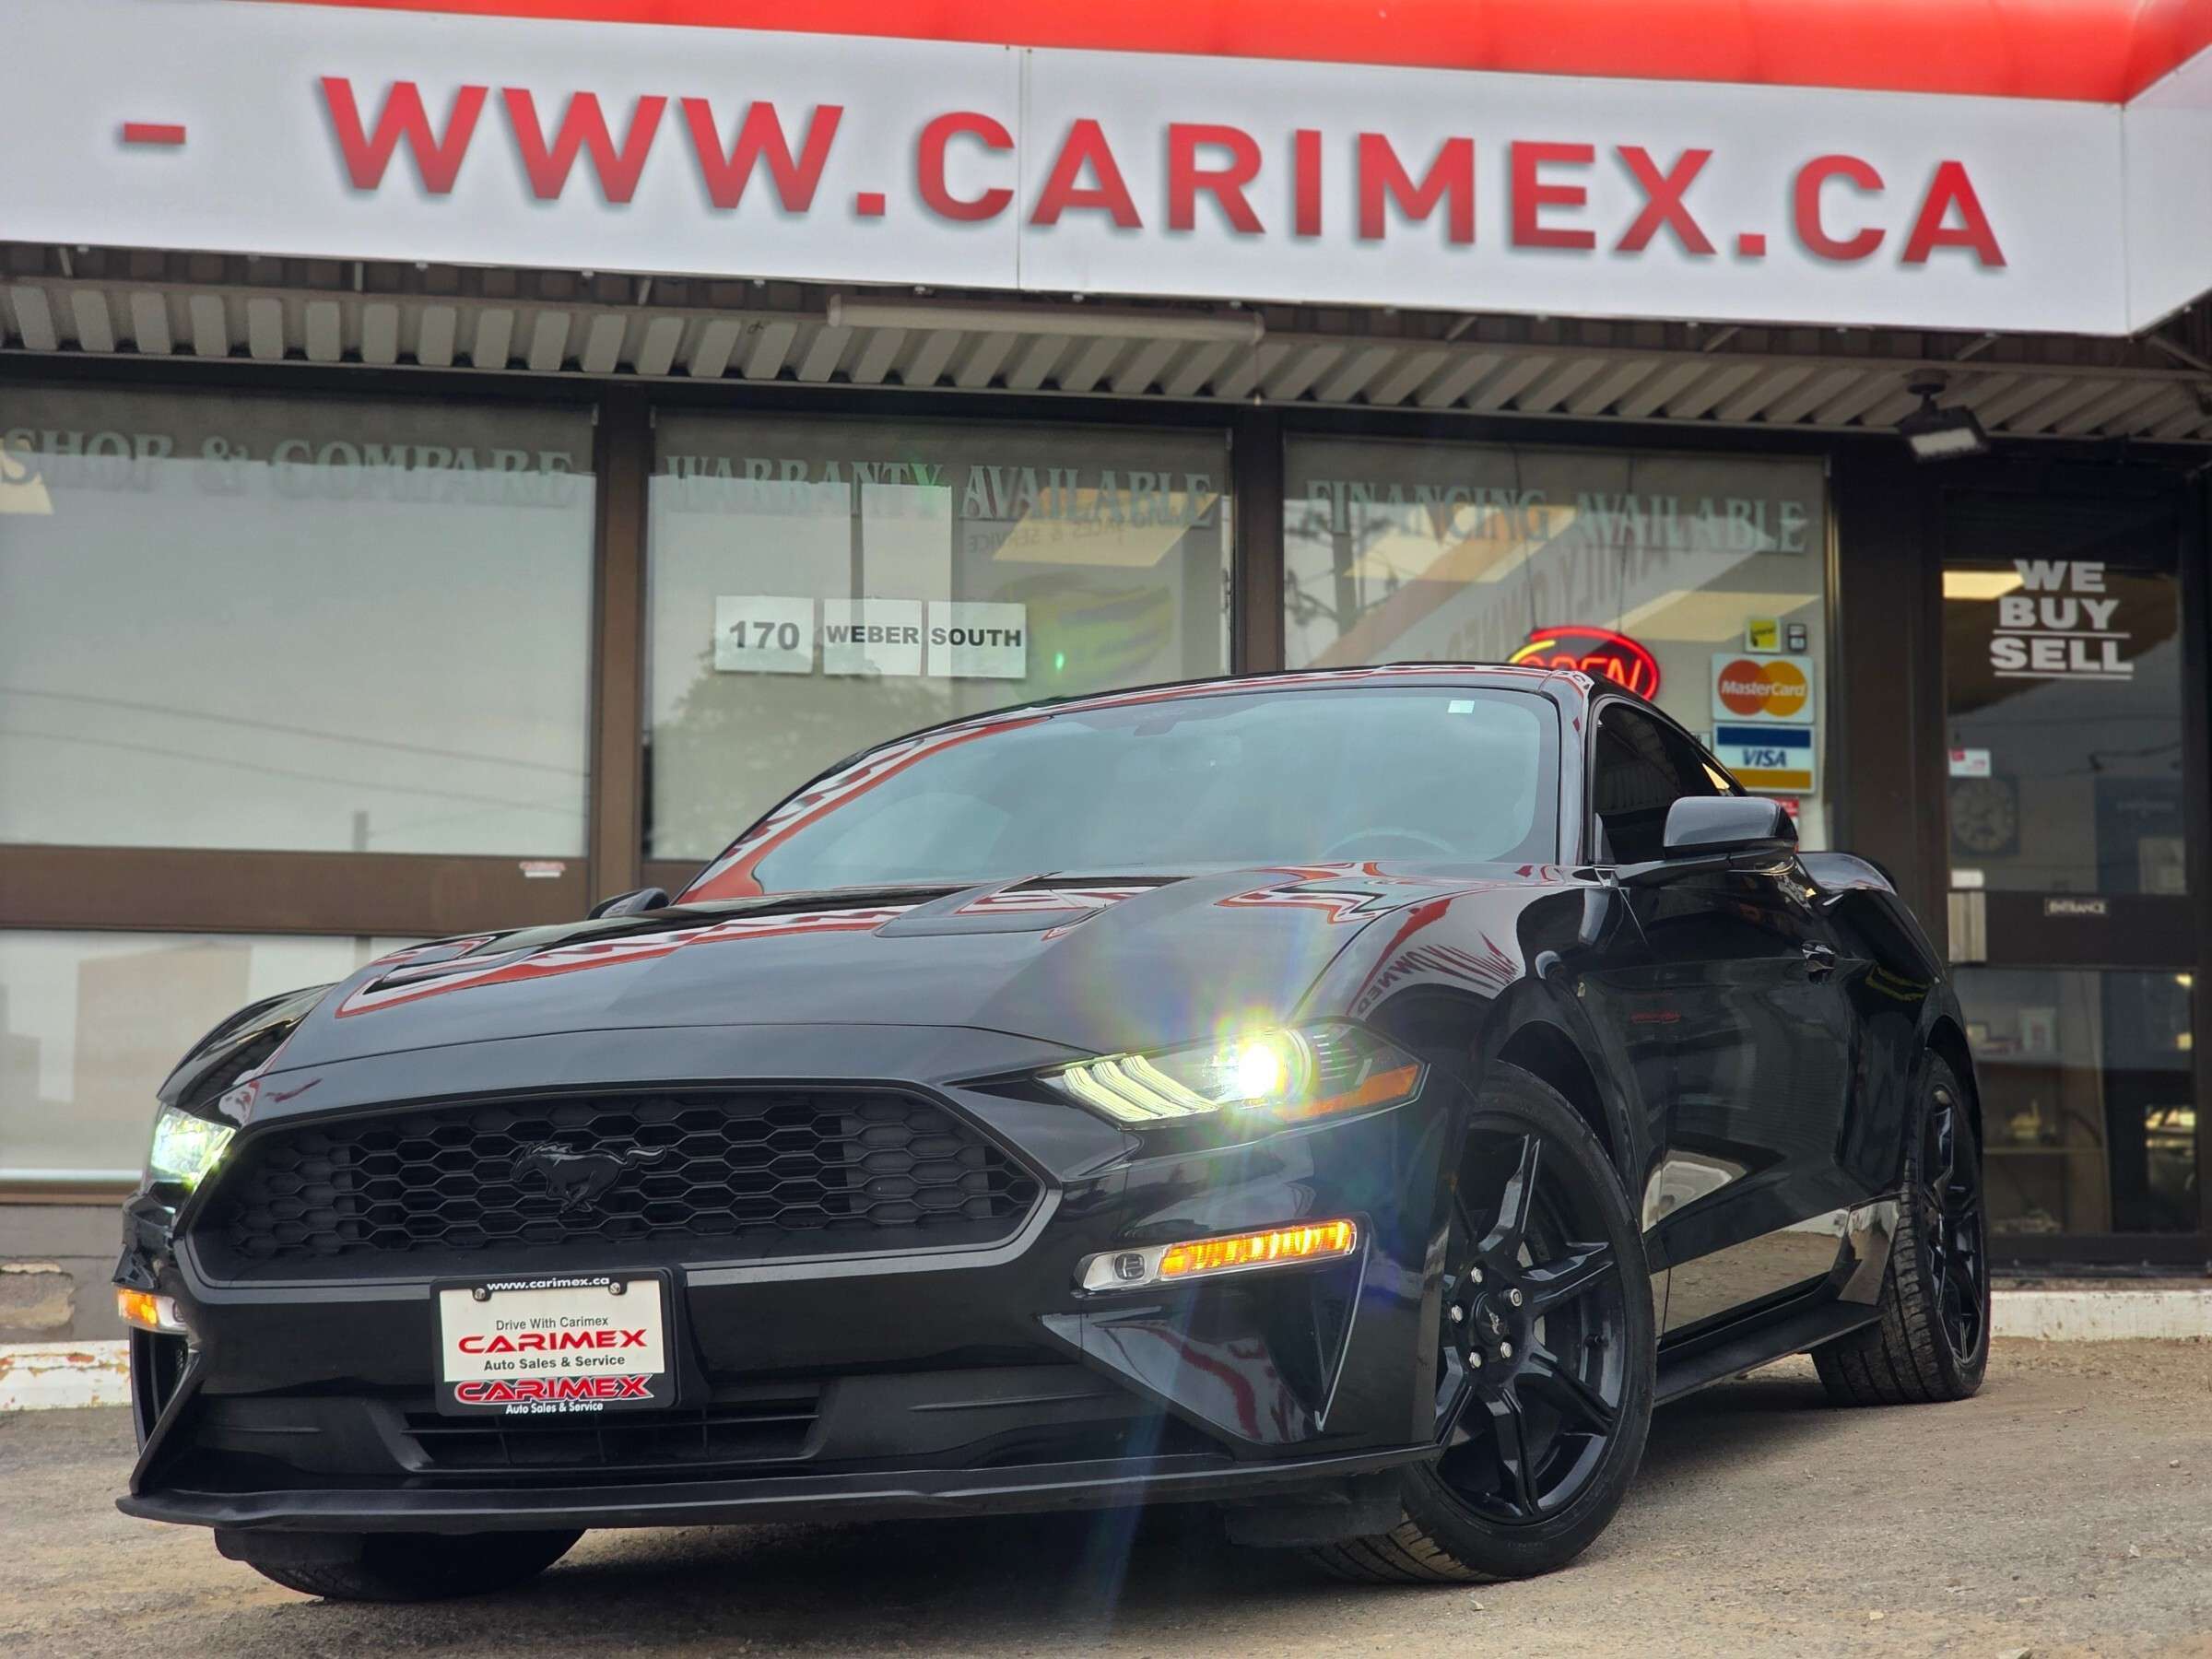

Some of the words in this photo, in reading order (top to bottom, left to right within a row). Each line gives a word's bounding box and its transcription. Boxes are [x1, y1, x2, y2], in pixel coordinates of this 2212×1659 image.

[320, 76, 2006, 267] WWW.CARIMEX.CA
[2, 428, 173, 494] SHOP
[195, 435, 250, 497] &
[274, 438, 574, 508] COMPARE
[664, 455, 946, 518] WARRANTY
[959, 464, 1215, 527] AVAILABLE
[1305, 479, 1549, 542] FINANCING
[1574, 492, 1807, 553] AVAILABLE
[2014, 559, 2106, 592] WE
[1999, 596, 2120, 630] BUY
[729, 620, 800, 651] 170
[826, 625, 920, 645] WEBER
[931, 627, 1021, 647] SOUTH
[1990, 638, 2134, 672] SELL
[1722, 680, 1806, 697] MasterCard
[1743, 747, 1788, 767] VISA
[487, 1277, 610, 1291] www.carimex.ca
[496, 1320, 526, 1331] Drive
[529, 1318, 557, 1329] With
[559, 1315, 609, 1327] Carimex
[458, 1330, 647, 1354] CARIMEX
[484, 1359, 515, 1371] Auto
[519, 1358, 557, 1370] Sales
[560, 1357, 571, 1367] &
[575, 1355, 626, 1367] Service
[454, 1375, 653, 1404] CARIMEX
[506, 1404, 529, 1415] Auto
[532, 1403, 557, 1413] Sales
[559, 1402, 568, 1412] &
[569, 1401, 604, 1412] Service
